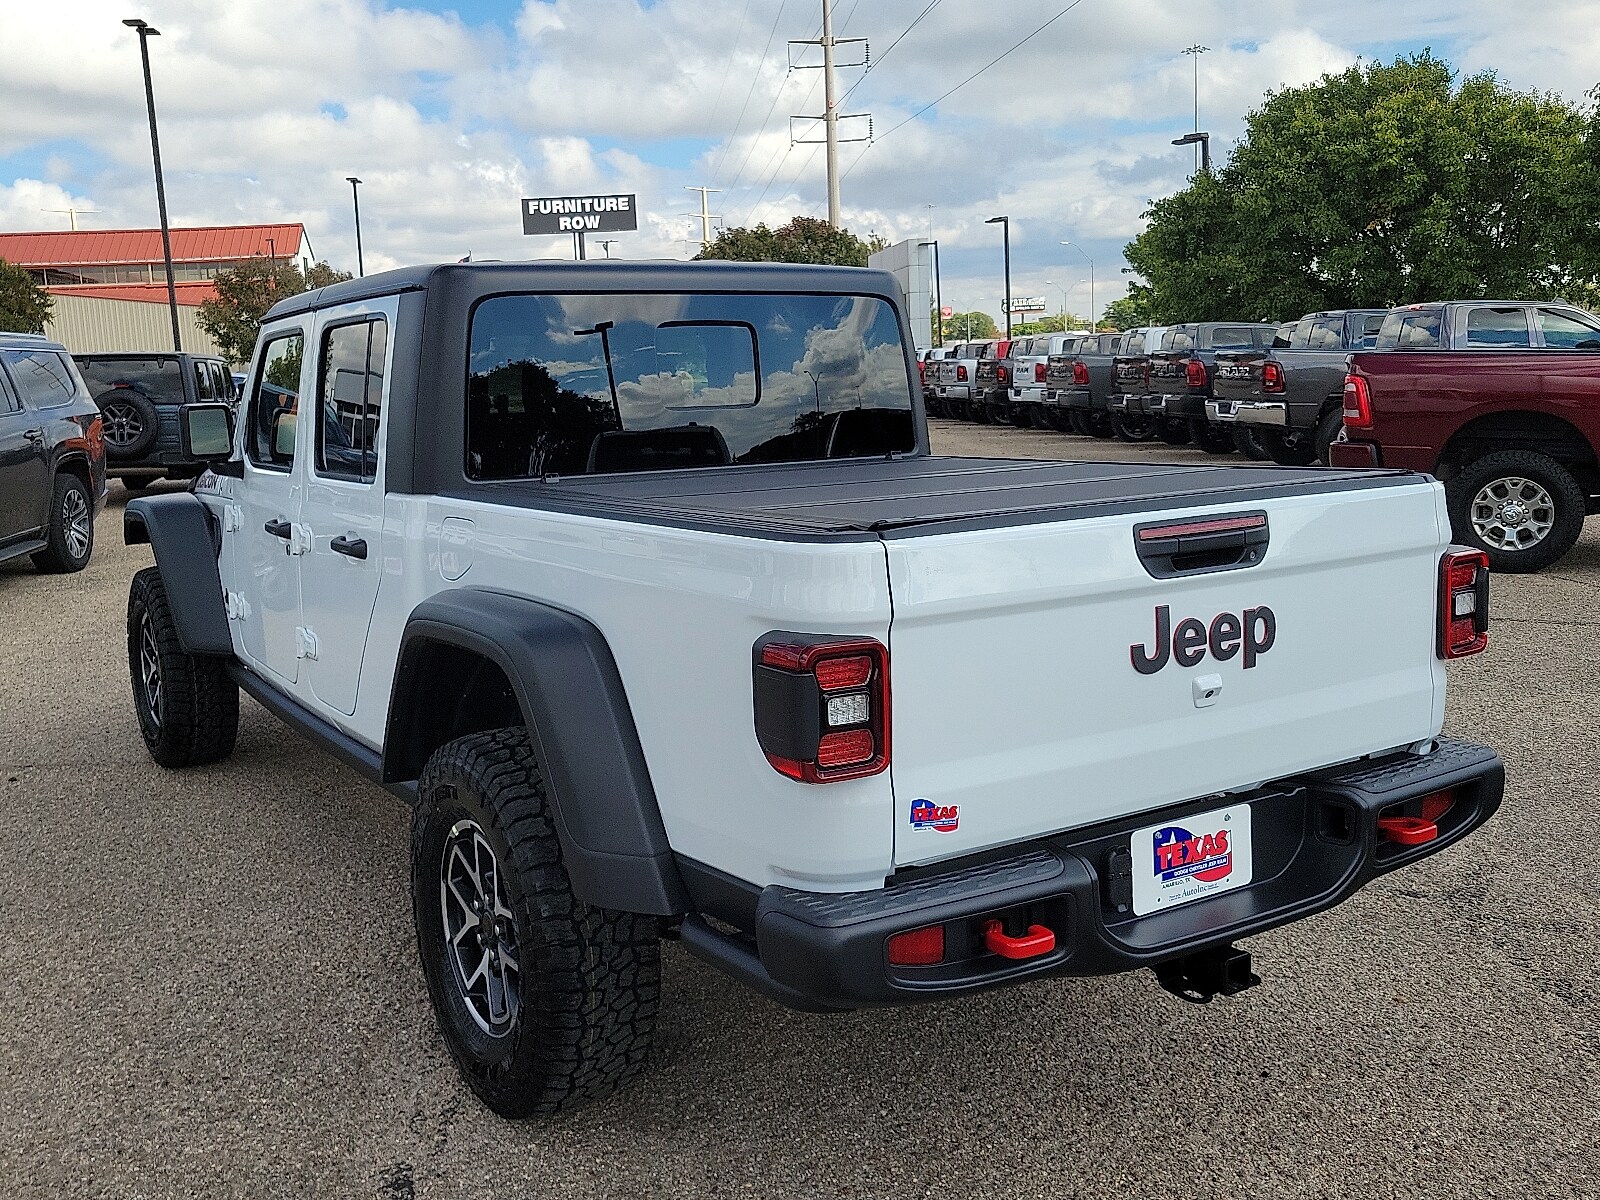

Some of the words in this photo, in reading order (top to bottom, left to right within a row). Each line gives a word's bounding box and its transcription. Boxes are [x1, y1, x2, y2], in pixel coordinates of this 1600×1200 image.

[528, 197, 630, 215] FURNITURE
[559, 216, 600, 231] ROW
[1129, 604, 1276, 675] Jeep
[913, 805, 958, 822] TEXAS
[1157, 830, 1229, 870] TEXAS
